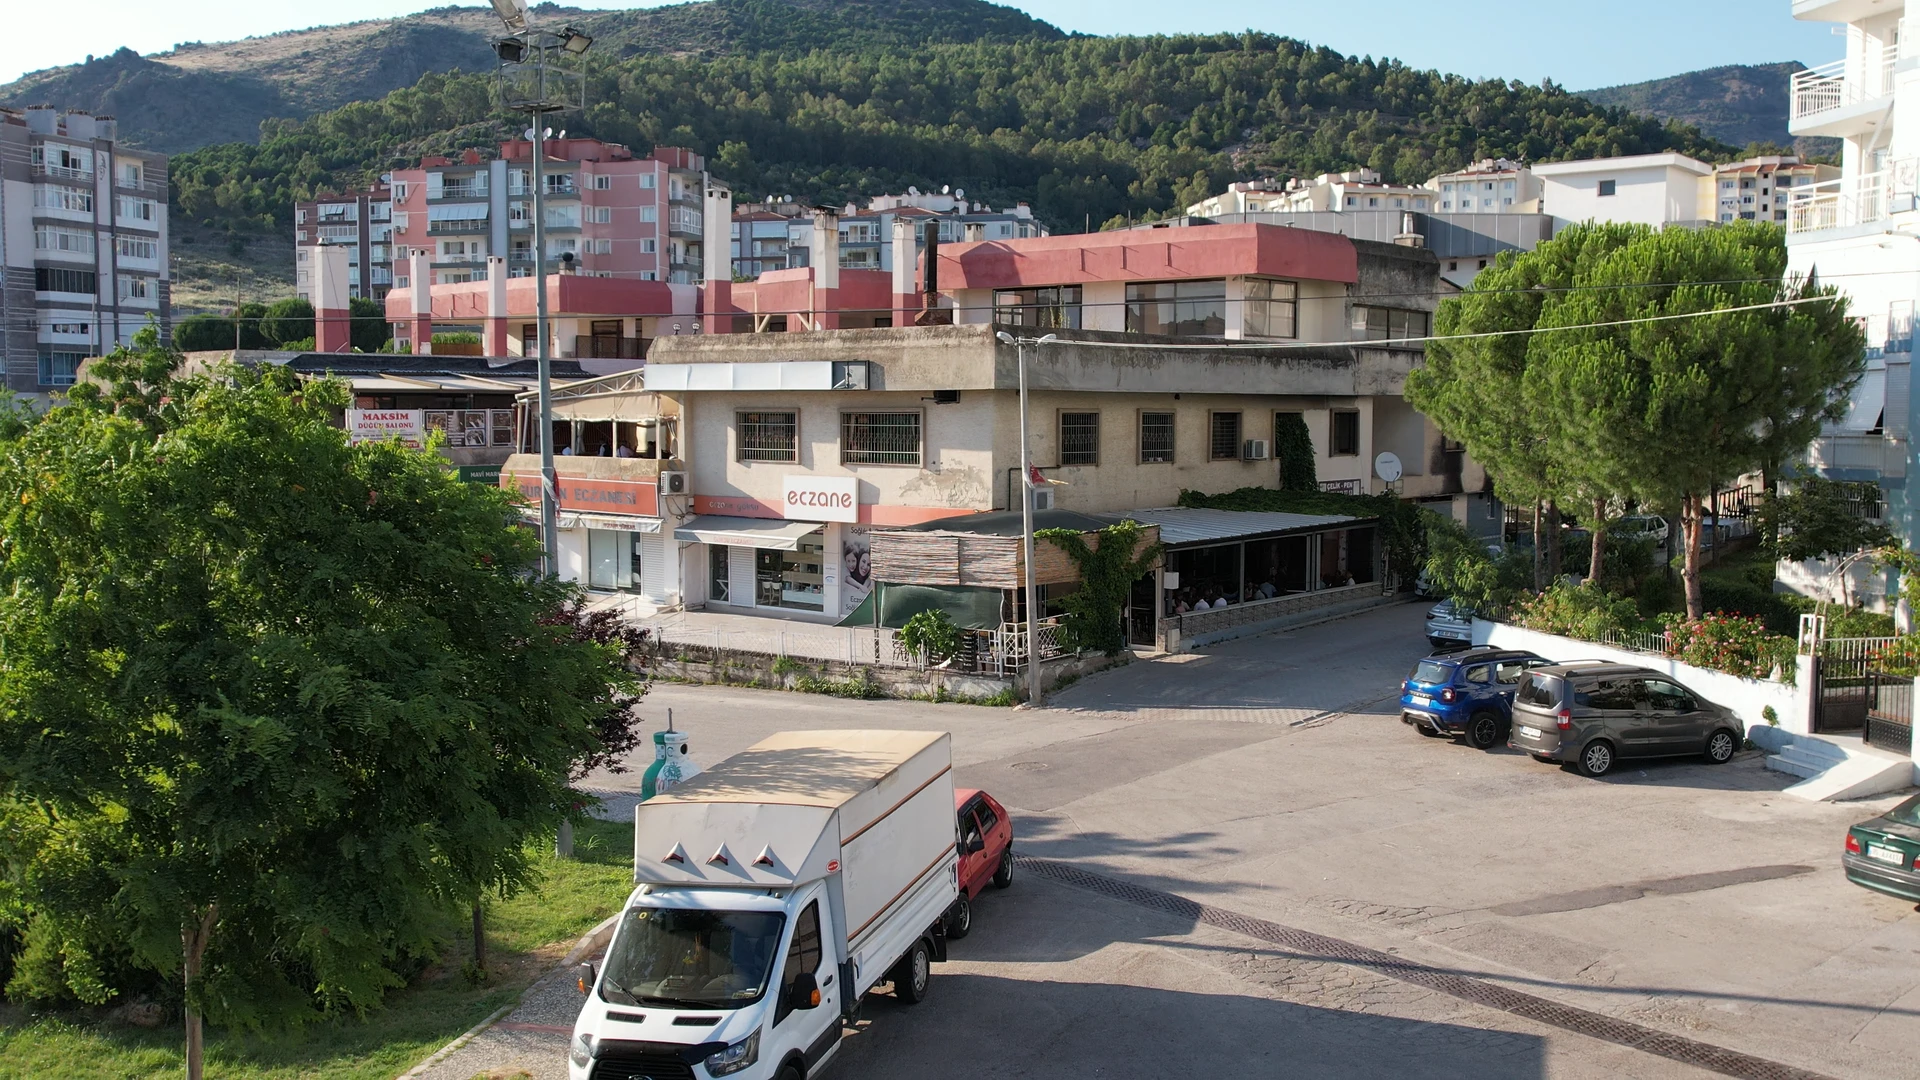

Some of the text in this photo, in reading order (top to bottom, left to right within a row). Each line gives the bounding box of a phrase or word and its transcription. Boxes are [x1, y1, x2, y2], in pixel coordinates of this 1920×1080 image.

[363, 412, 409, 420] MAKSİM
[574, 488, 637, 505] ECZANESİ
[787, 490, 852, 508] eczane
